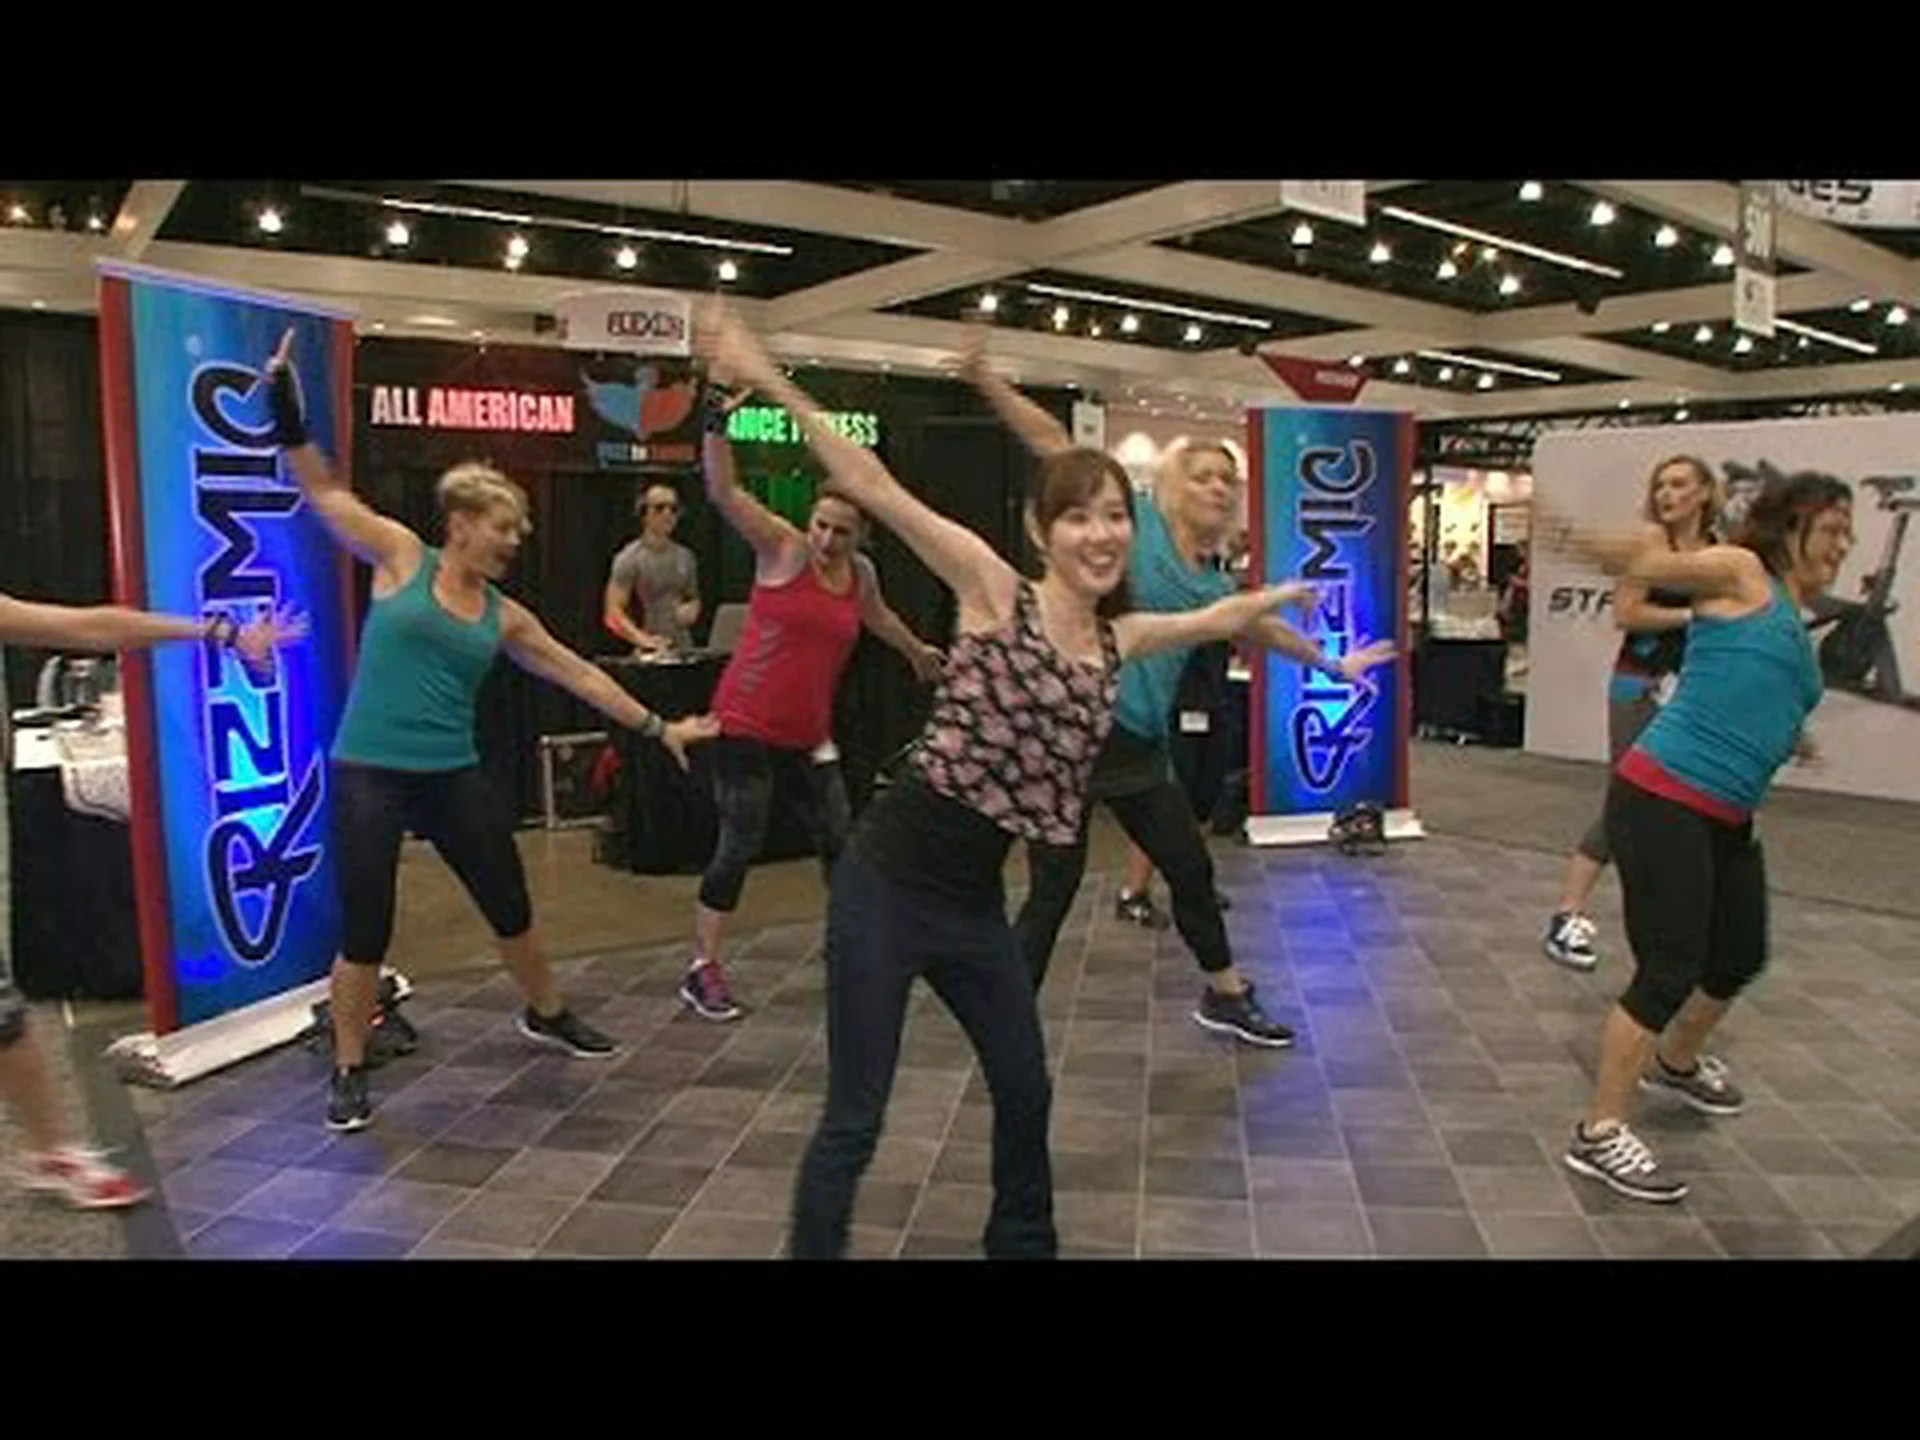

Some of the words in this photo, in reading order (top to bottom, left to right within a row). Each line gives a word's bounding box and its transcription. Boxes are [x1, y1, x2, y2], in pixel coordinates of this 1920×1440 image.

[371, 387, 422, 426] ALL
[427, 388, 575, 433] AMERICAN
[725, 406, 788, 442] ANCE
